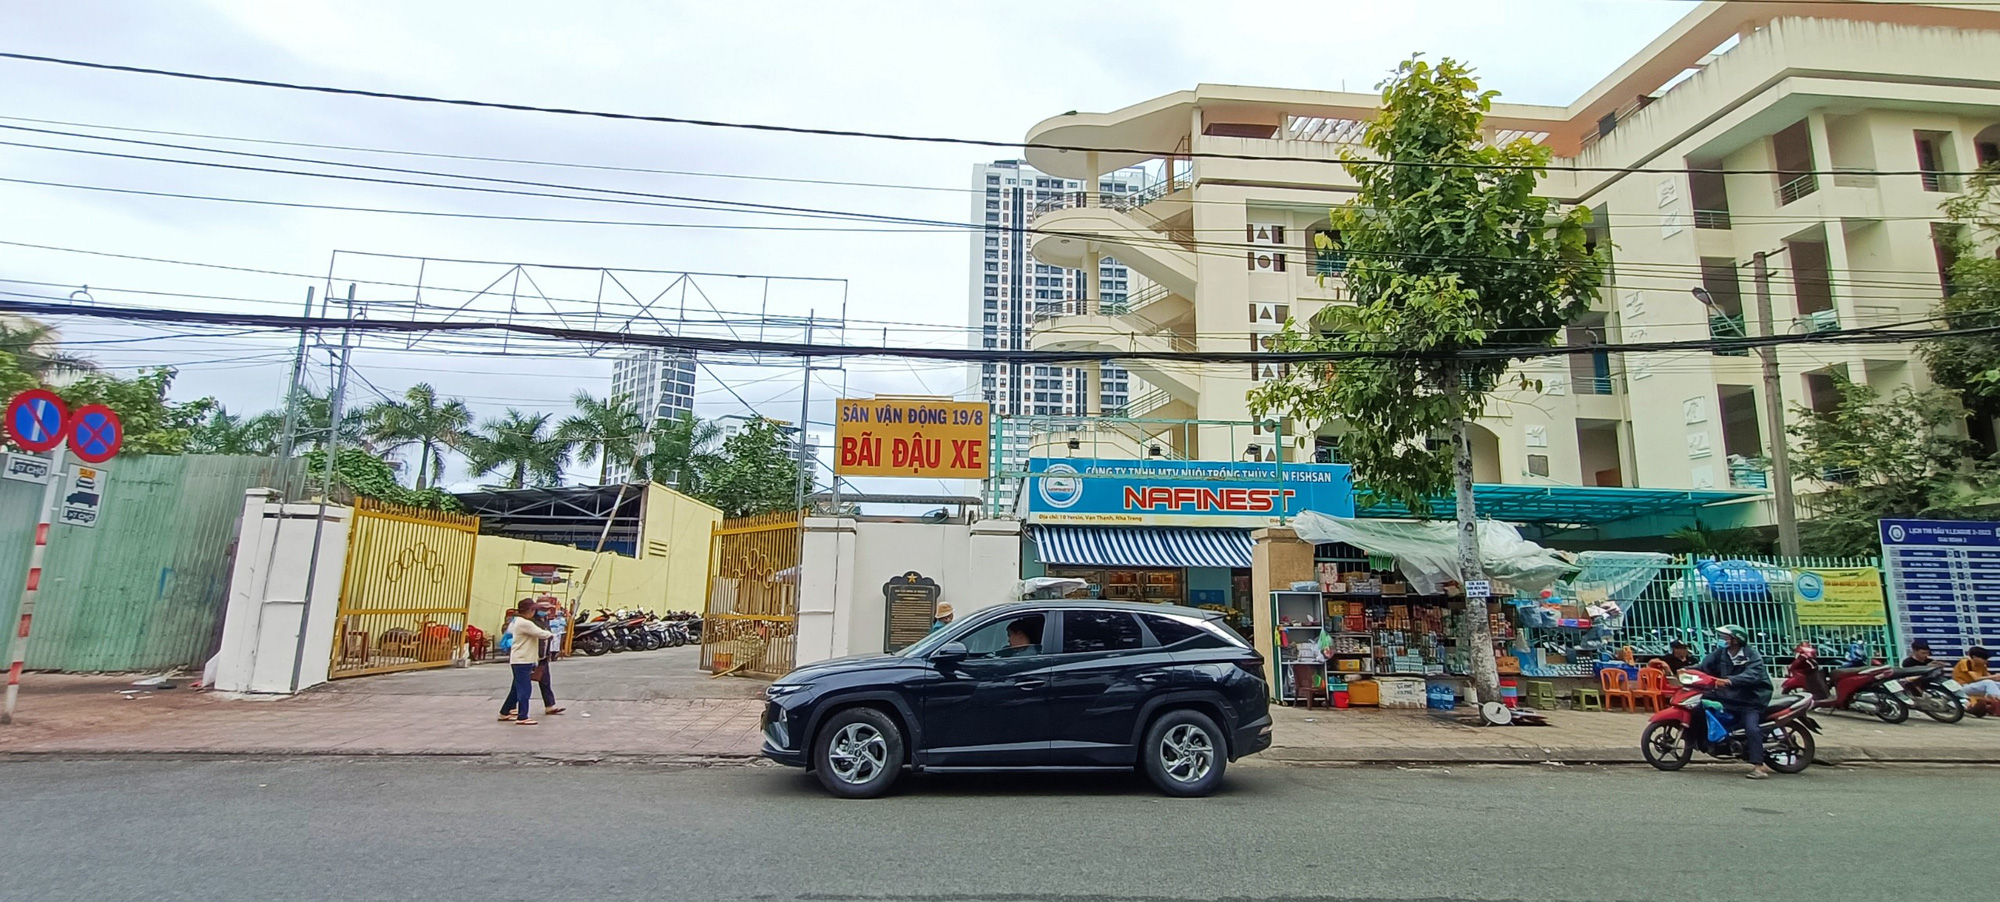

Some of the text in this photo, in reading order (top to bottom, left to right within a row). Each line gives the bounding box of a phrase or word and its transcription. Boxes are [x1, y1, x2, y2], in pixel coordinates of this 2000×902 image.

[843, 403, 983, 428] SÂN VẬN ĐỘNG 19/8
[841, 431, 982, 474] BÃI ĐẬU XE
[1270, 471, 1289, 482] SN
[1291, 470, 1332, 483] FISHSAN
[1124, 486, 1296, 512] NAFINEST
